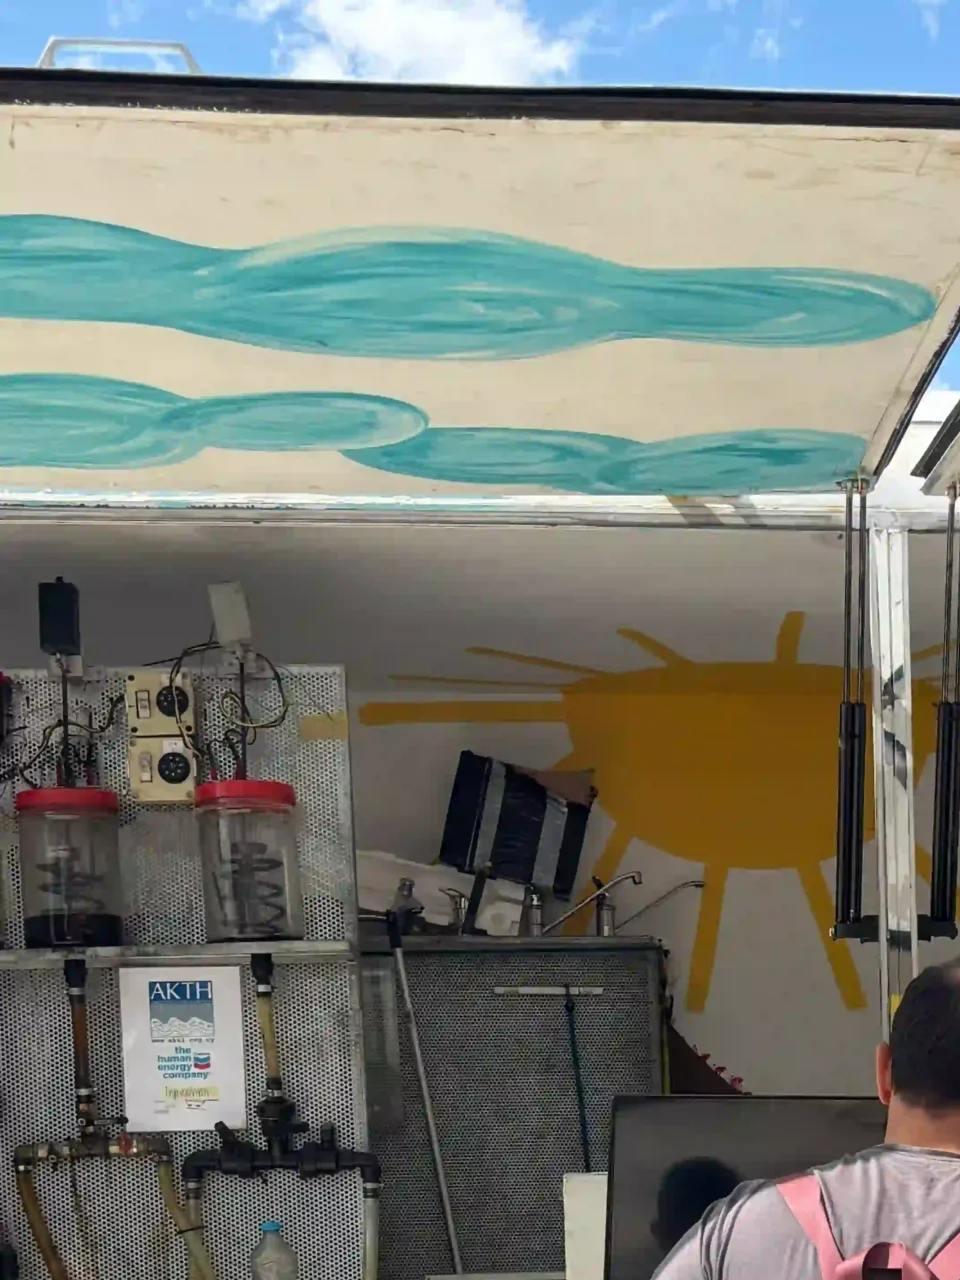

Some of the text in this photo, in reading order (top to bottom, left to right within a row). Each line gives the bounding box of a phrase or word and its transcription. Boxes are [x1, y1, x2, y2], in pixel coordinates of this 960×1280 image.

[174, 1046, 192, 1054] the
[157, 1055, 192, 1063] human
[157, 1063, 193, 1072] energy
[163, 1071, 209, 1080] company
